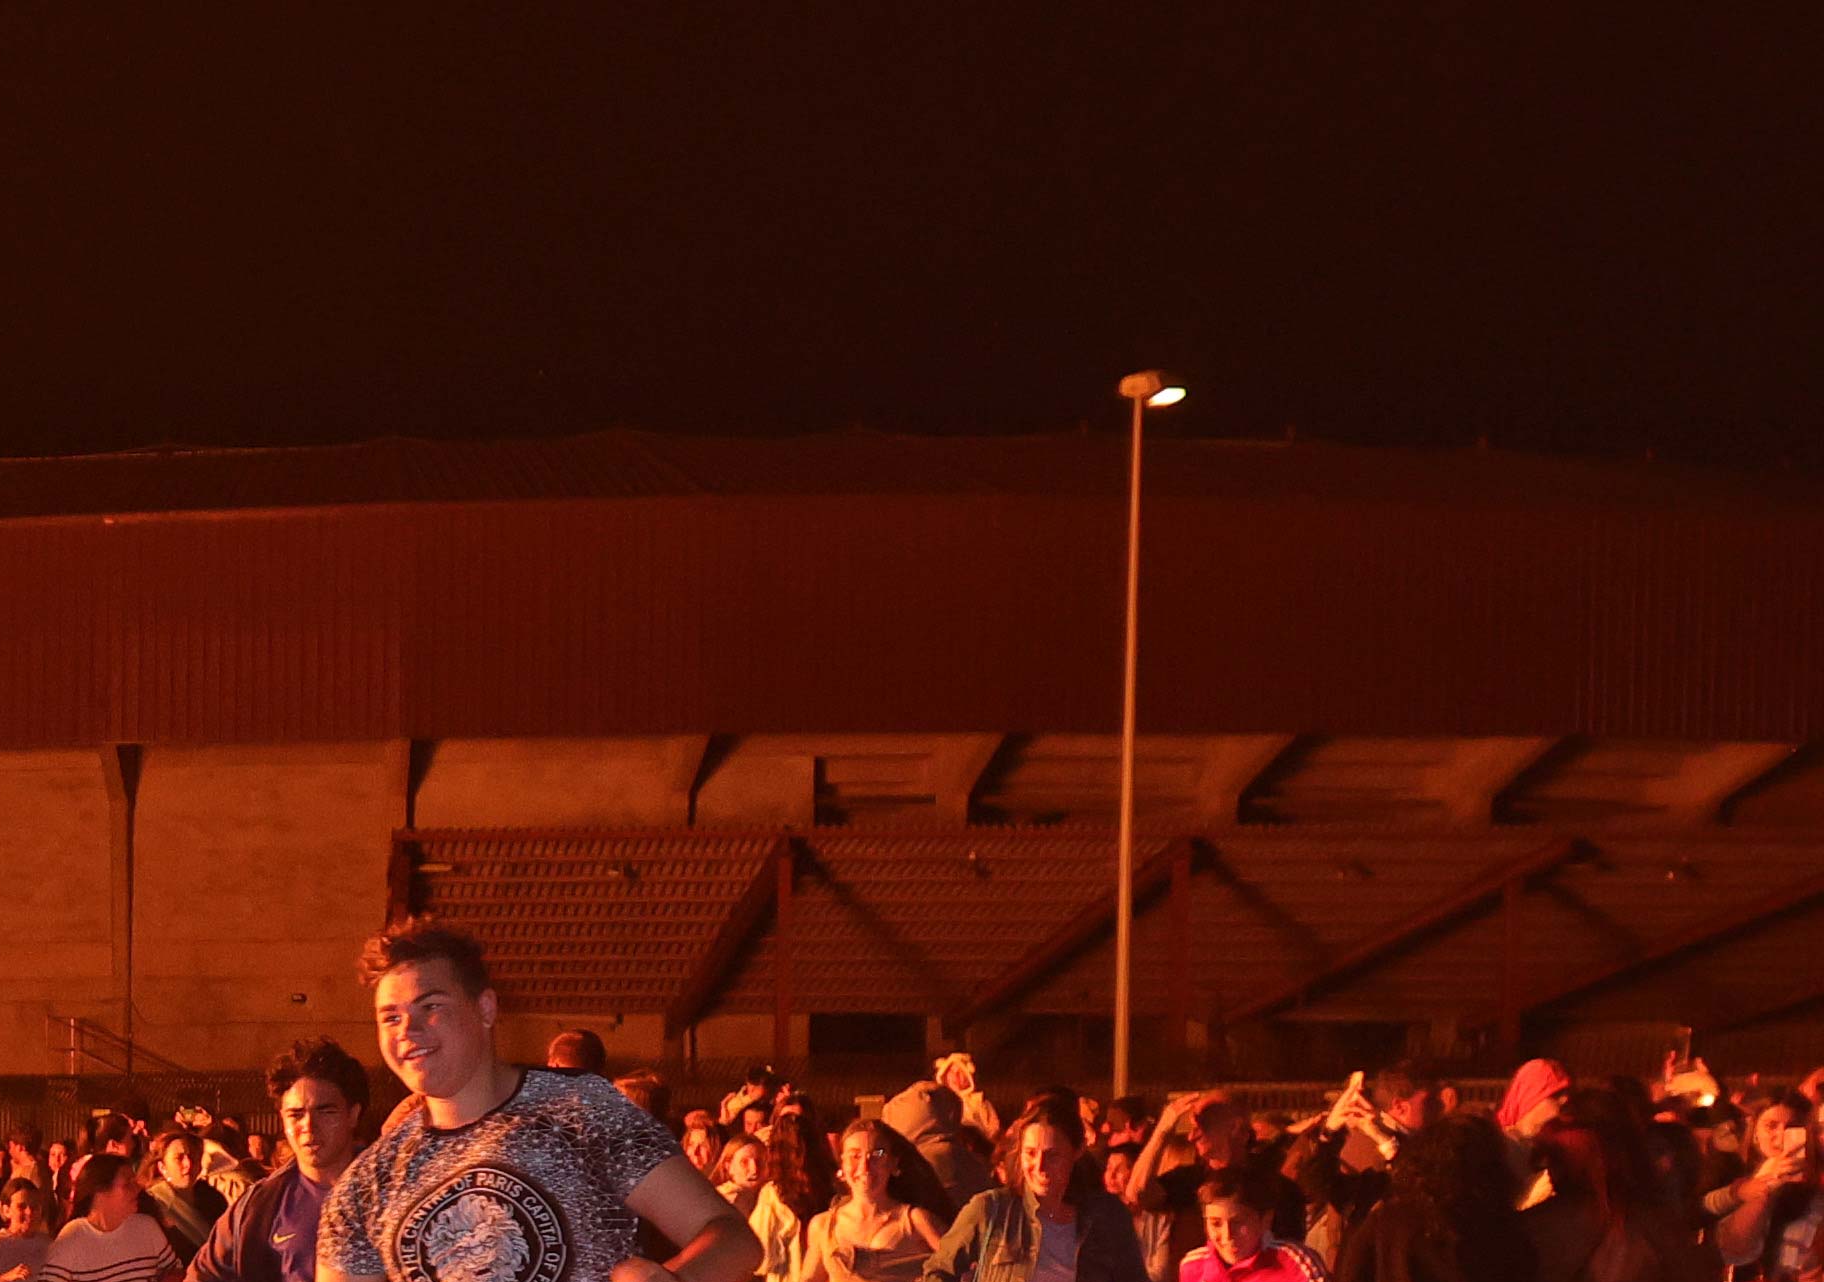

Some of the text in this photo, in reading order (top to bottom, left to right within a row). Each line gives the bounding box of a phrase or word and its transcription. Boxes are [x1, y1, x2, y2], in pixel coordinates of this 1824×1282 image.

[401, 1244, 419, 1273] THE
[454, 1174, 473, 1191] OF
[475, 1172, 523, 1198] PARIS
[522, 1196, 560, 1249] CAPITAL
[544, 1252, 561, 1272] OF
